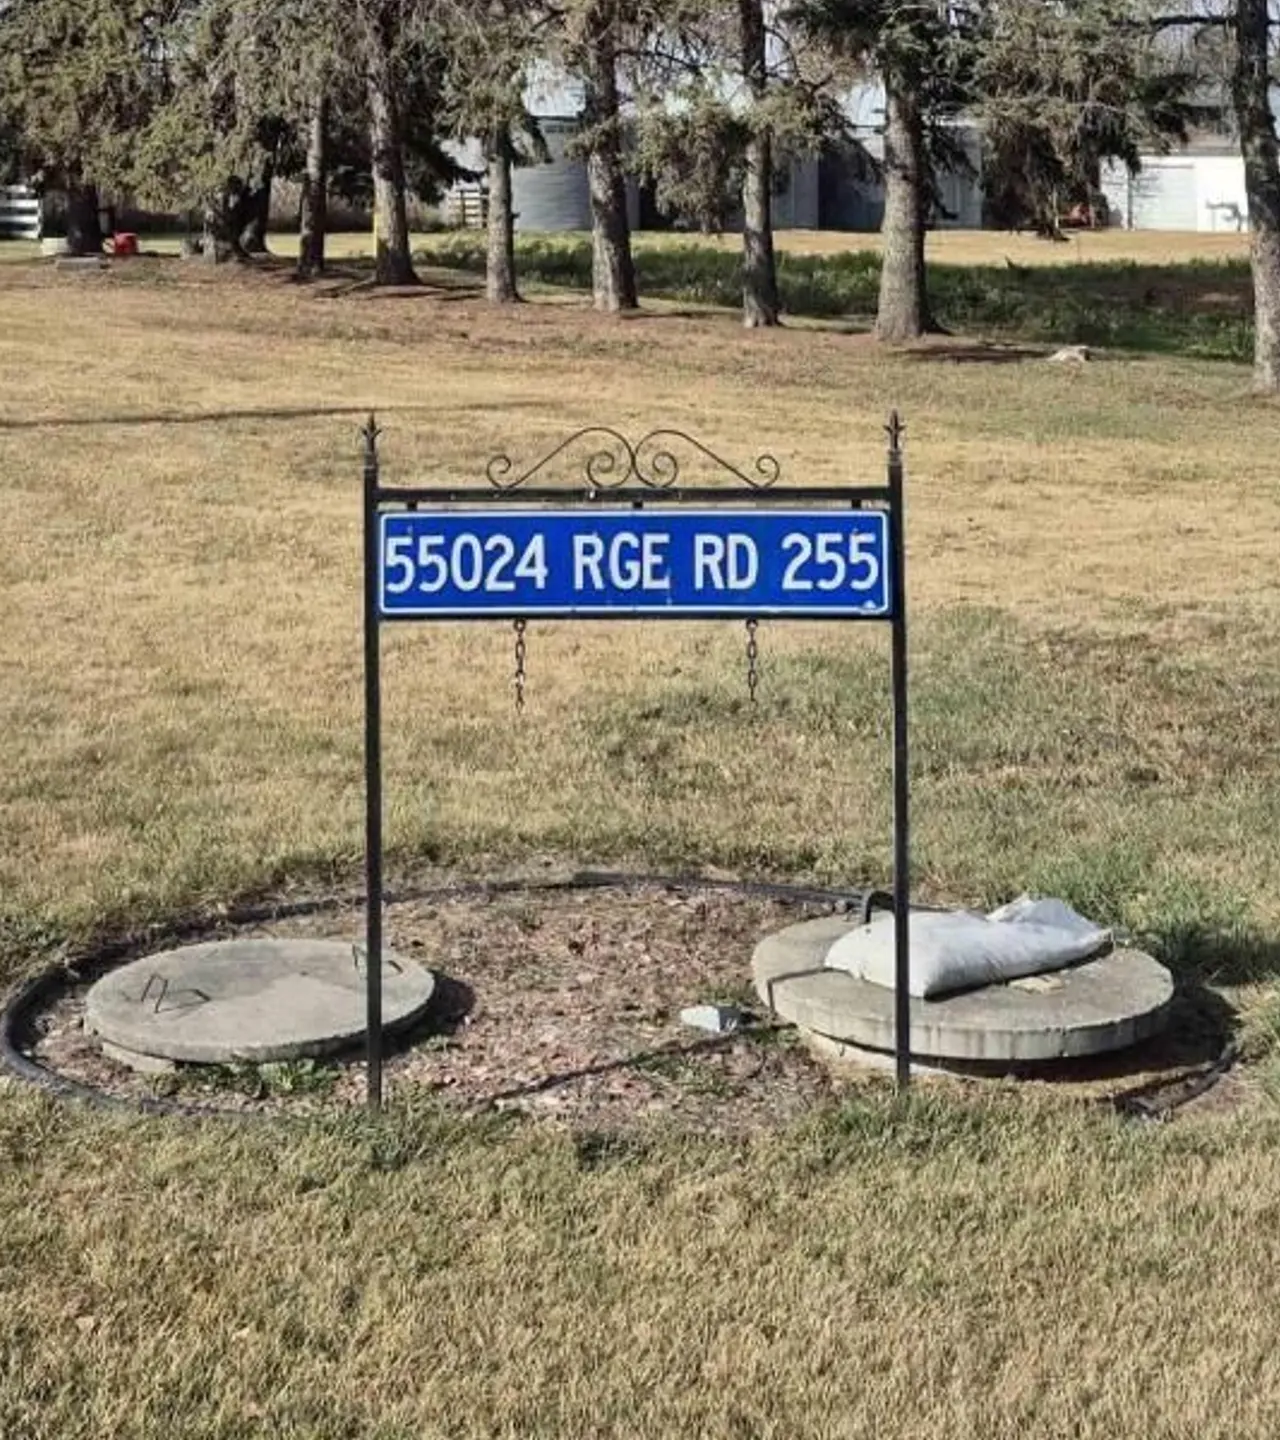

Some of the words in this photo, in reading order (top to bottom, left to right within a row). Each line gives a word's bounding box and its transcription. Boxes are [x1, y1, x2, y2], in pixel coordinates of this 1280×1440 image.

[385, 534, 548, 593] 55024
[573, 533, 670, 590] RGE
[694, 533, 758, 590] RD
[781, 532, 879, 591] 255
